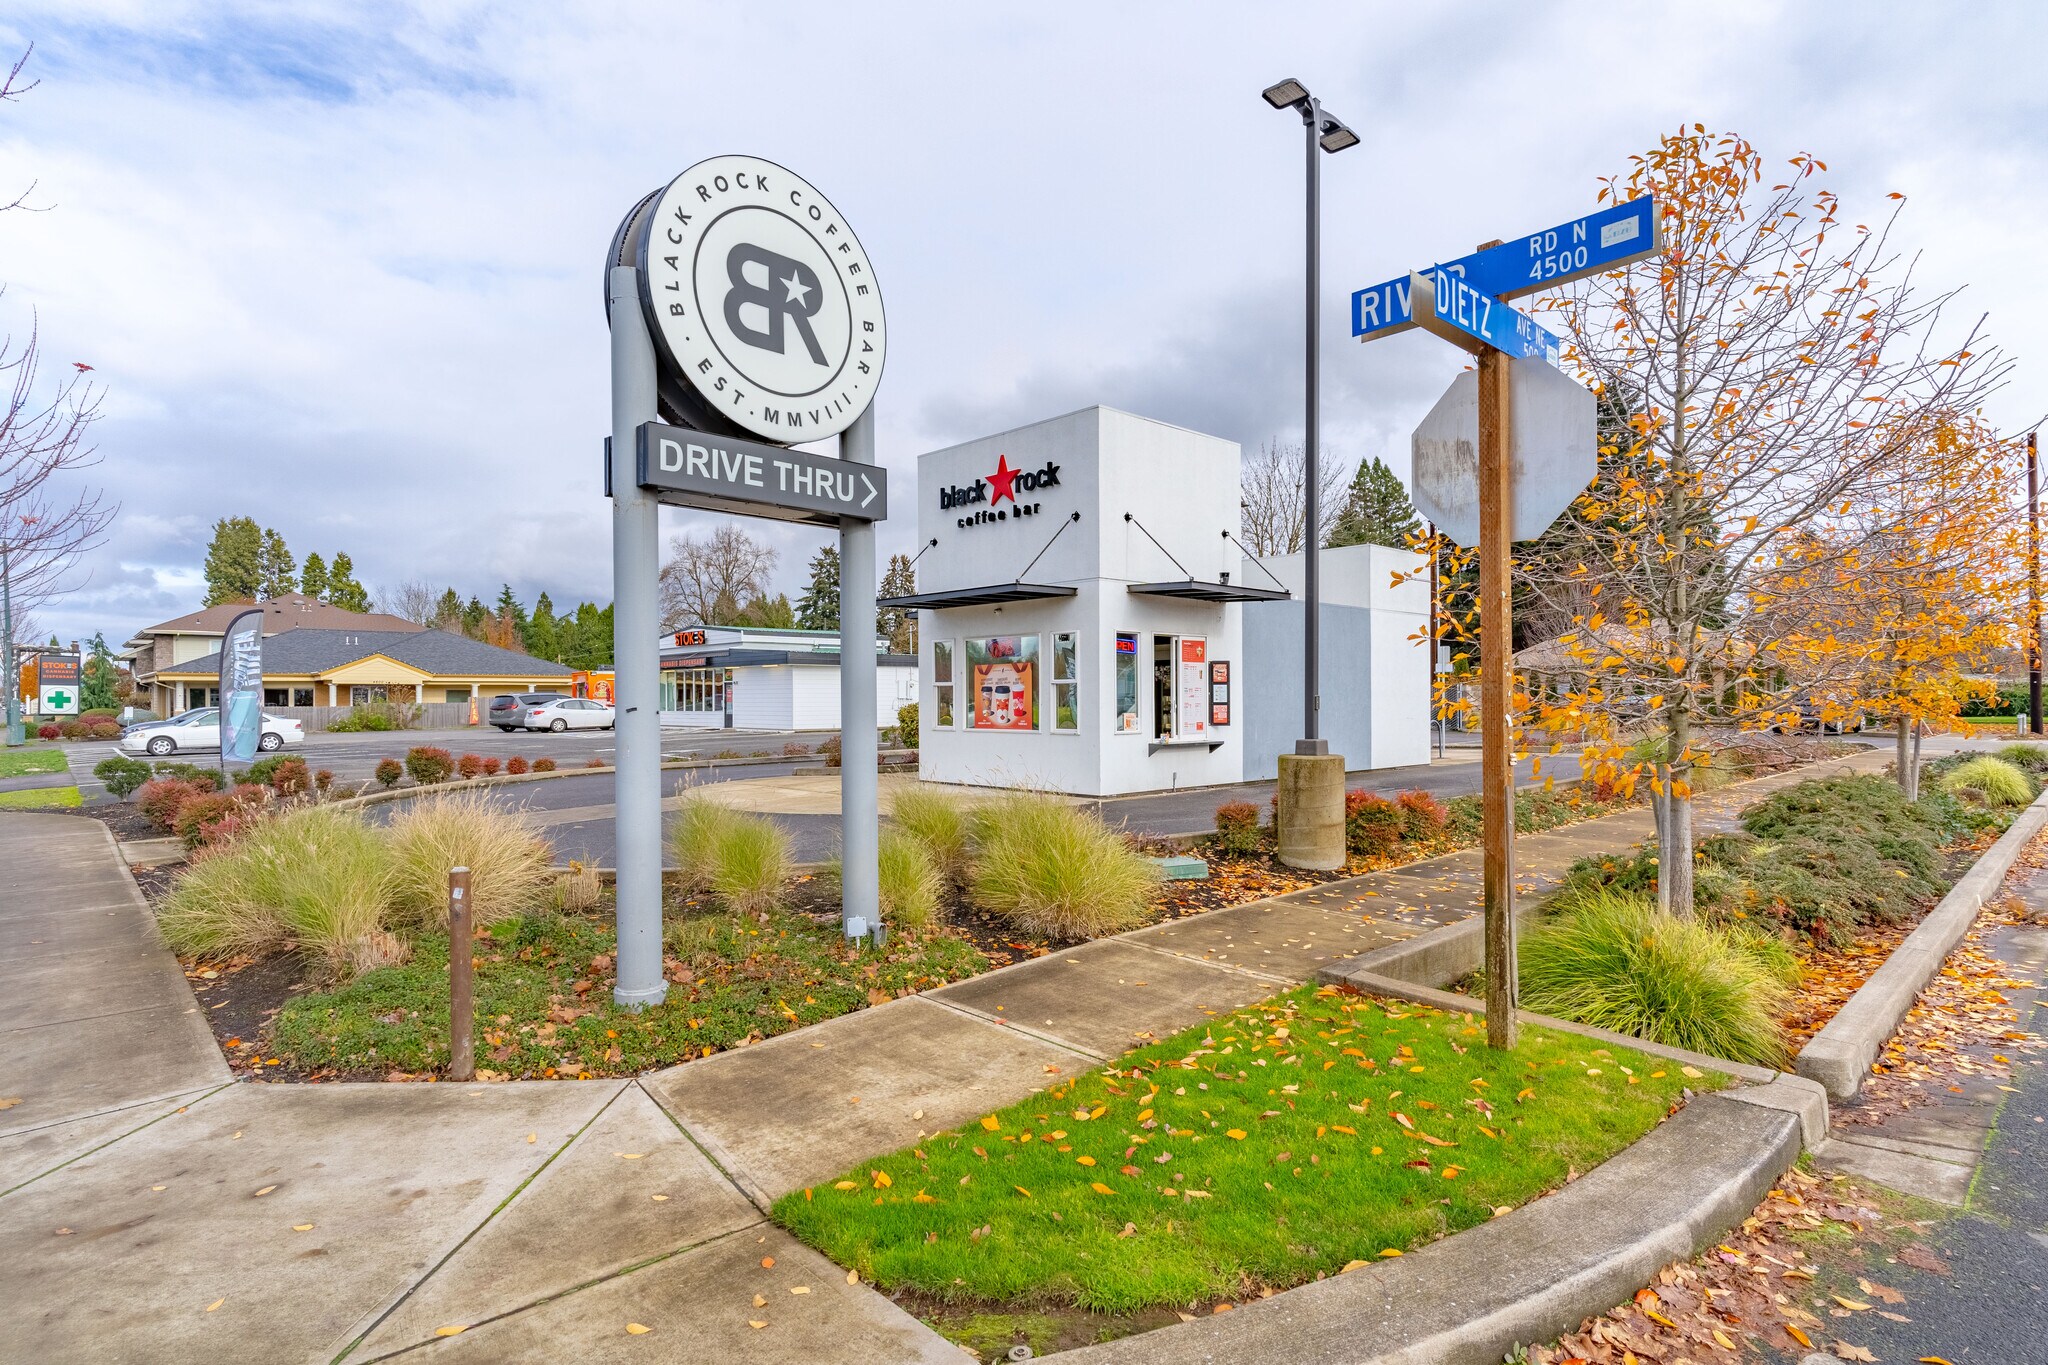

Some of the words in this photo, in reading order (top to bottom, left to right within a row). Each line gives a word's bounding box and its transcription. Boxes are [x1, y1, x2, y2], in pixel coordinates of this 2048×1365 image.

[1529, 230, 1558, 258] RD
[1573, 220, 1587, 242] N
[663, 206, 693, 317] BLACK
[695, 173, 770, 203] ROCK
[789, 190, 869, 296] COFFEE
[857, 320, 876, 376] BAR
[1529, 246, 1588, 281] 4500
[1437, 269, 1492, 339] DIETZ
[1516, 315, 1532, 341] AVE
[1535, 326, 1546, 349] NE
[764, 392, 852, 427] MMVIII
[659, 438, 764, 488] DRIVE
[773, 461, 855, 502] THRU
[940, 479, 988, 509] black
[1014, 461, 1061, 493] rock
[957, 510, 1006, 529] coffee
[1012, 503, 1040, 518] bar
[1116, 641, 1135, 651] PEN
